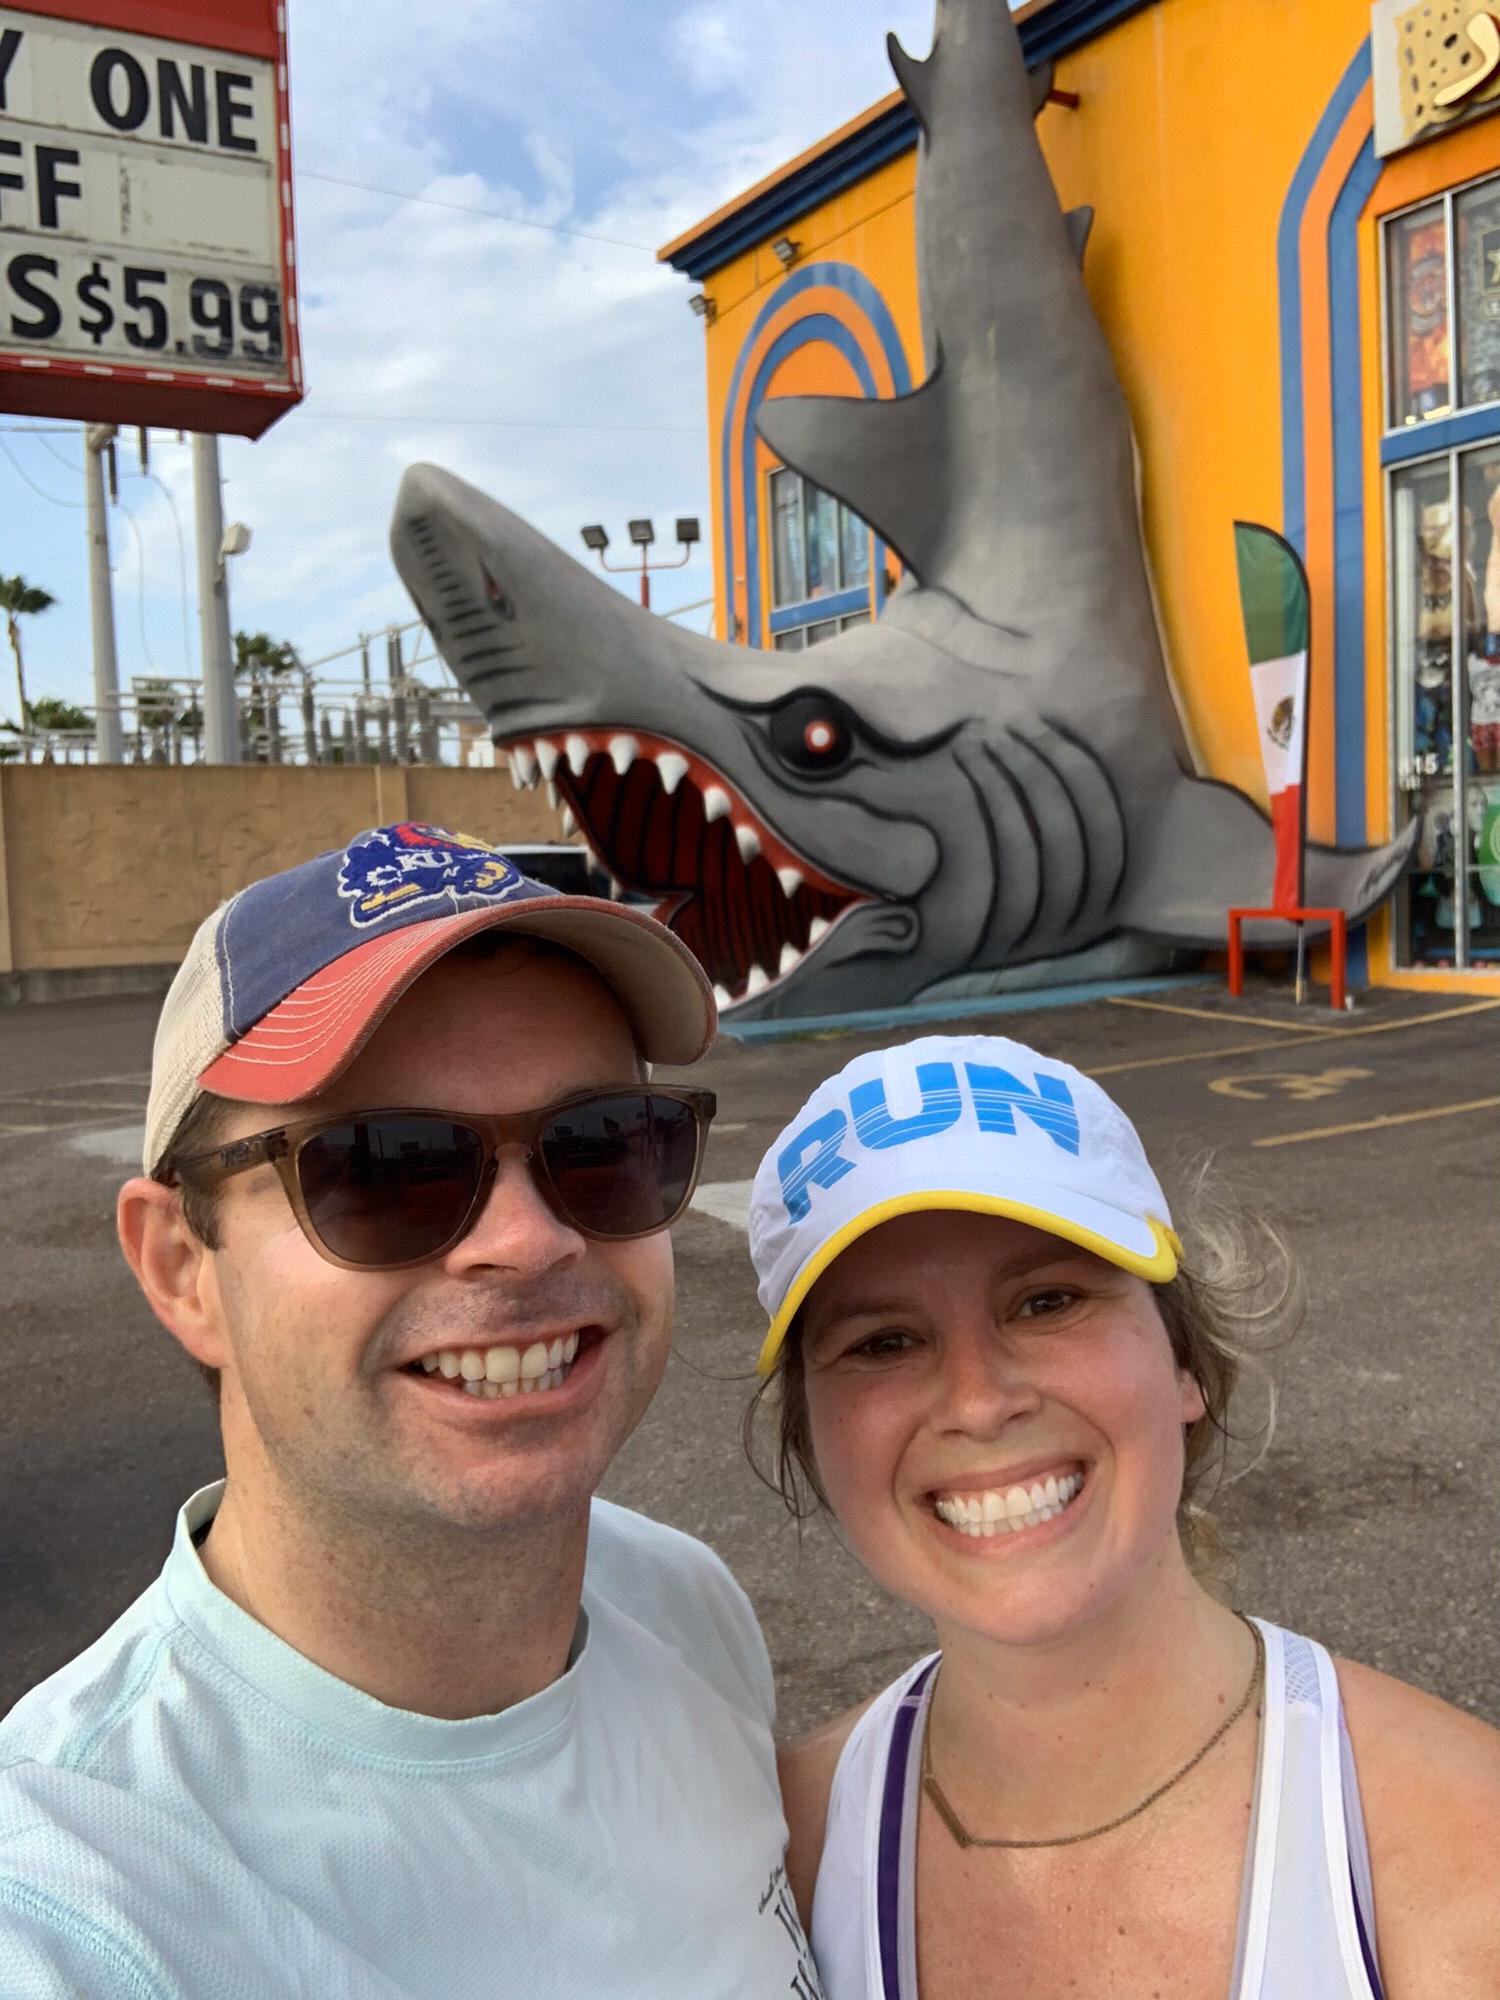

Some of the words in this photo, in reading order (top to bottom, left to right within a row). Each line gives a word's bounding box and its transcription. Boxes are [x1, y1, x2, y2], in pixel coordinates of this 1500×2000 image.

[90, 48, 257, 152] ONE
[395, 851, 454, 872] KU
[777, 1062, 1080, 1226] RUN
